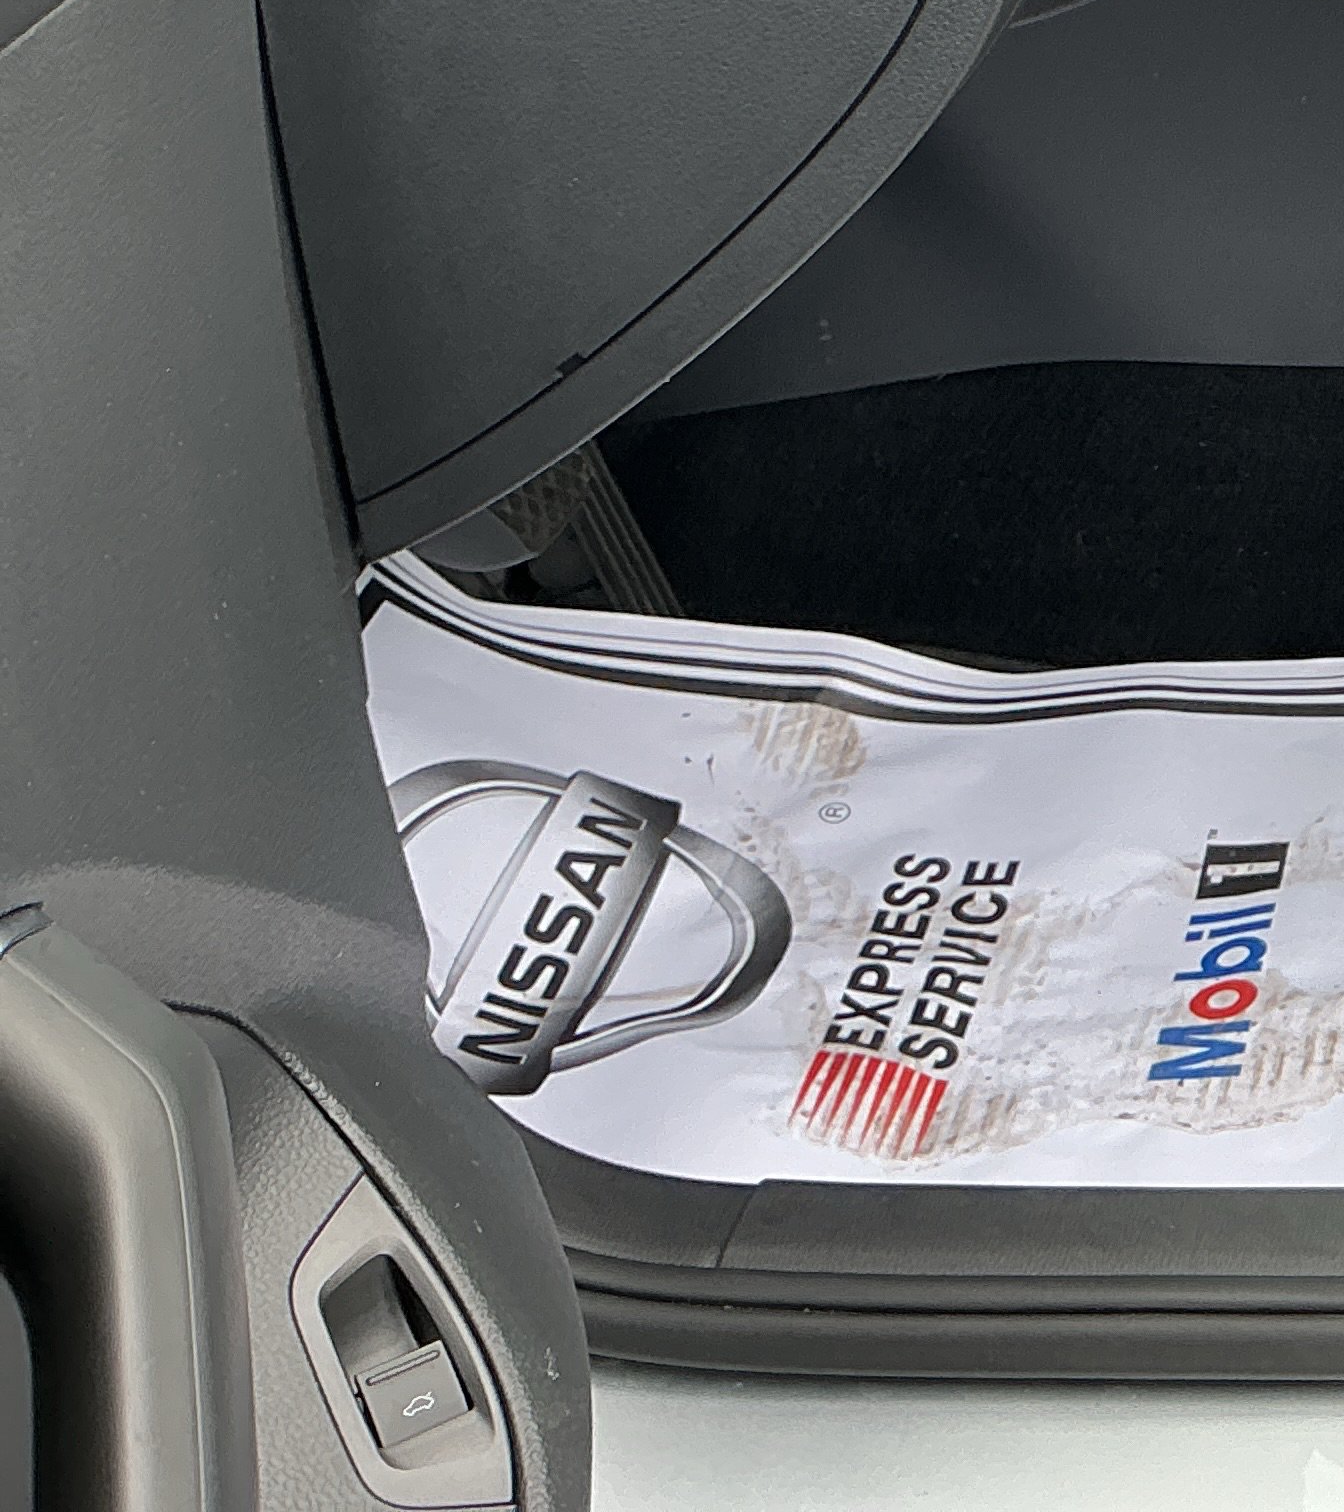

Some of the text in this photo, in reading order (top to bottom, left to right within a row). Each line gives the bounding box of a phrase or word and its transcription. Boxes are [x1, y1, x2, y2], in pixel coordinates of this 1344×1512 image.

[458, 797, 646, 1065] NISSAN
[823, 853, 952, 1052] EXPRESS
[899, 859, 1021, 1070] SERVICE
[1147, 901, 1277, 1081] Mobil
